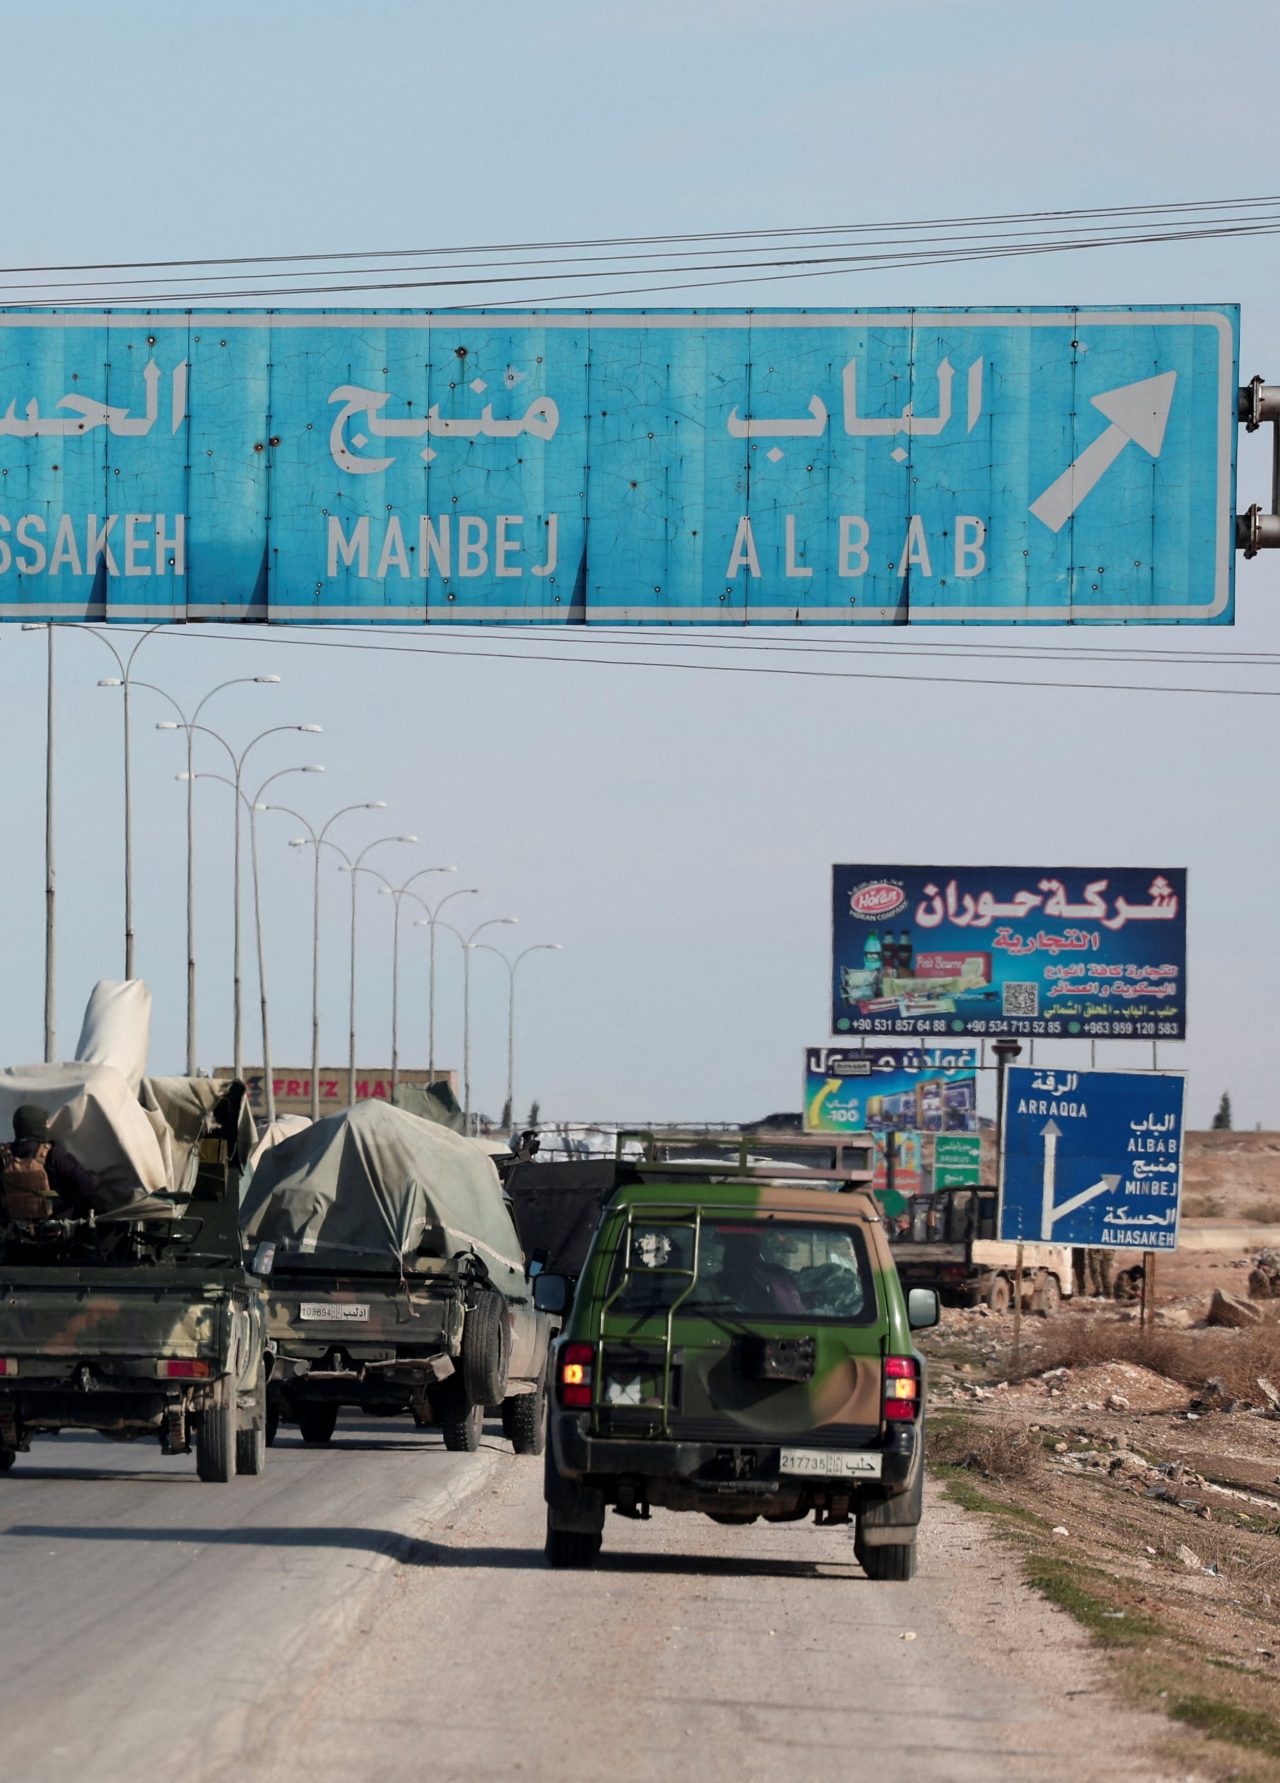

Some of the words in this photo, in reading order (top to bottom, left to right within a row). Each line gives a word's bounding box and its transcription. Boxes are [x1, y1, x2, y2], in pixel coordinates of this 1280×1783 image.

[727, 356, 983, 464] الباب
[328, 377, 559, 475] منبج
[328, 515, 558, 578] MANBEJ
[915, 879, 1043, 927] حوران
[1039, 876, 1178, 931] شركة
[992, 928, 1100, 956] التجارية
[1086, 963, 1124, 978] كافة
[1097, 984, 1110, 997] و
[1110, 980, 1177, 999] البسكويت
[852, 1018, 871, 1031] +90
[874, 1018, 892, 1031] 531
[895, 1019, 913, 1032] 857
[916, 1019, 930, 1032] 64
[966, 1019, 986, 1032] +90
[988, 1020, 1008, 1032] 534
[1010, 1020, 1030, 1033] 713
[1032, 1021, 1045, 1033] 52
[1047, 1021, 1061, 1033] 85
[1083, 1021, 1110, 1034] +963
[1135, 1021, 1155, 1034] 120
[1031, 1072, 1079, 1095] الرقة
[1018, 1100, 1087, 1117] ARRAQQA
[1130, 1112, 1176, 1136] الباب
[1132, 1157, 1178, 1179] منبج
[1125, 1181, 1177, 1196] MINBEJ
[1104, 1205, 1176, 1225] الحسكة
[1102, 1230, 1175, 1246] ALHASAKEH
[846, 1457, 875, 1474] حلب
